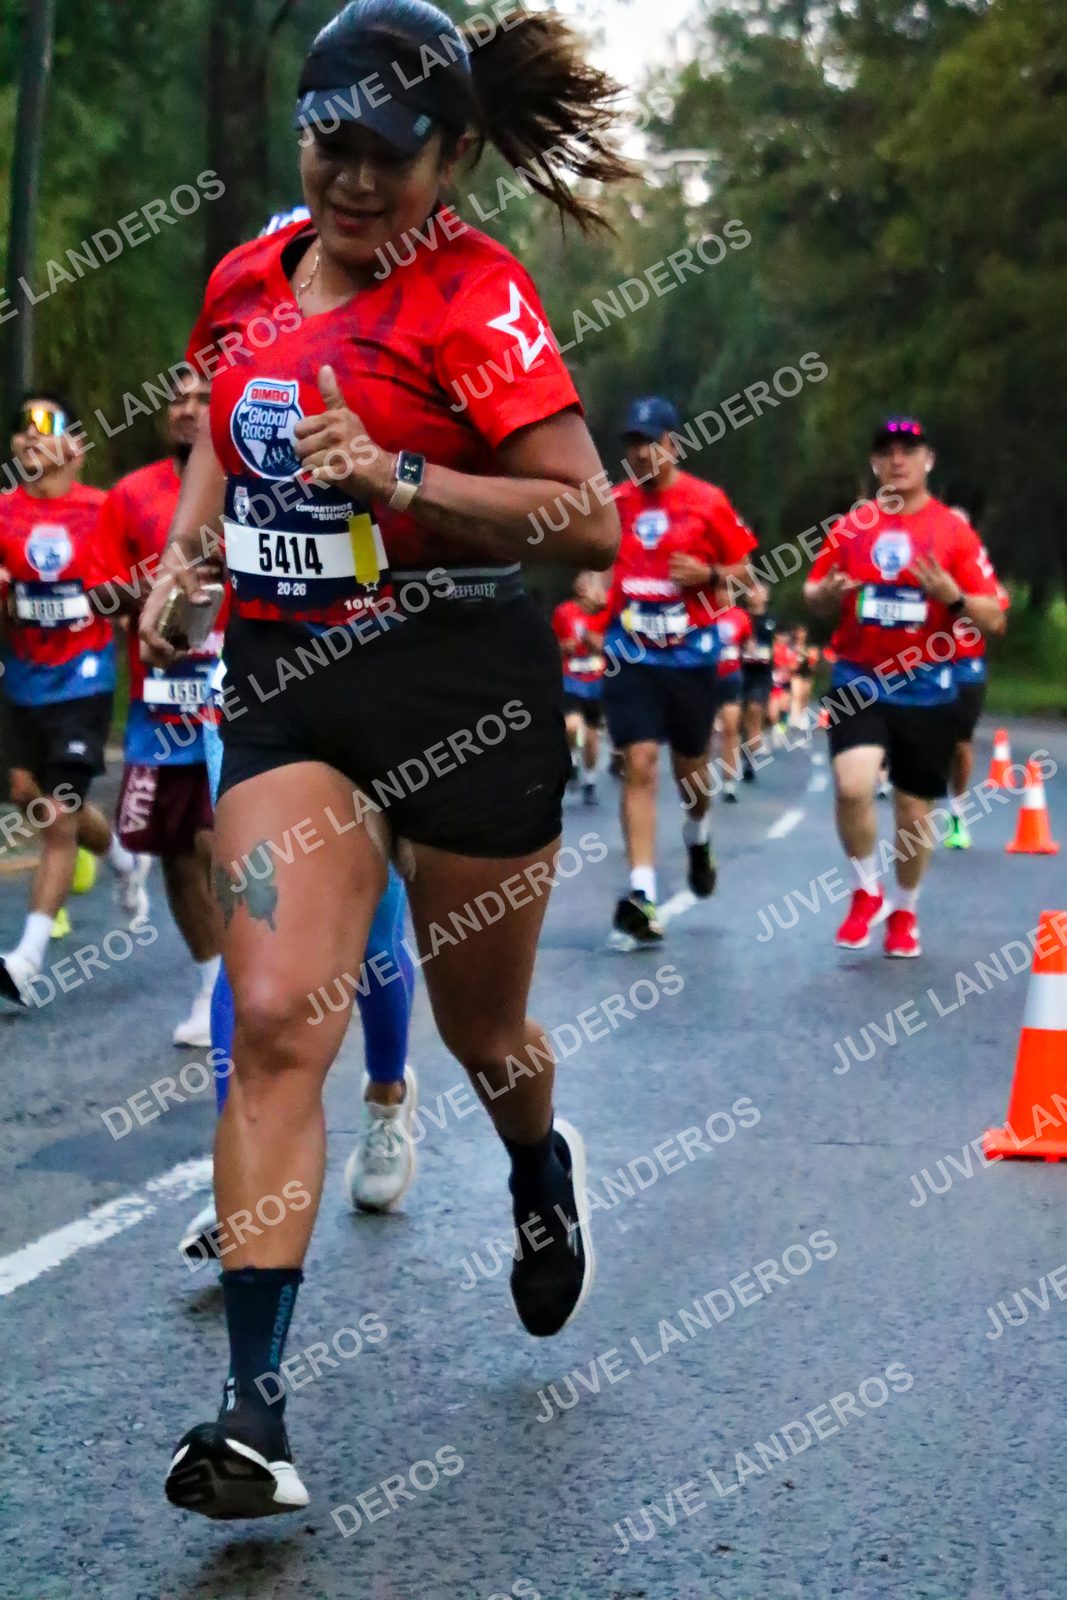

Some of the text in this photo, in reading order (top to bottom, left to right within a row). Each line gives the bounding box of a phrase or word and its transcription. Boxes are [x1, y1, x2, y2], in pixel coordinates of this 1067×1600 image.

[251, 388, 290, 403] BIMBO
[248, 408, 288, 427] Global
[241, 421, 273, 440] Race
[258, 533, 324, 576] 5414
[343, 596, 375, 611] 10K
